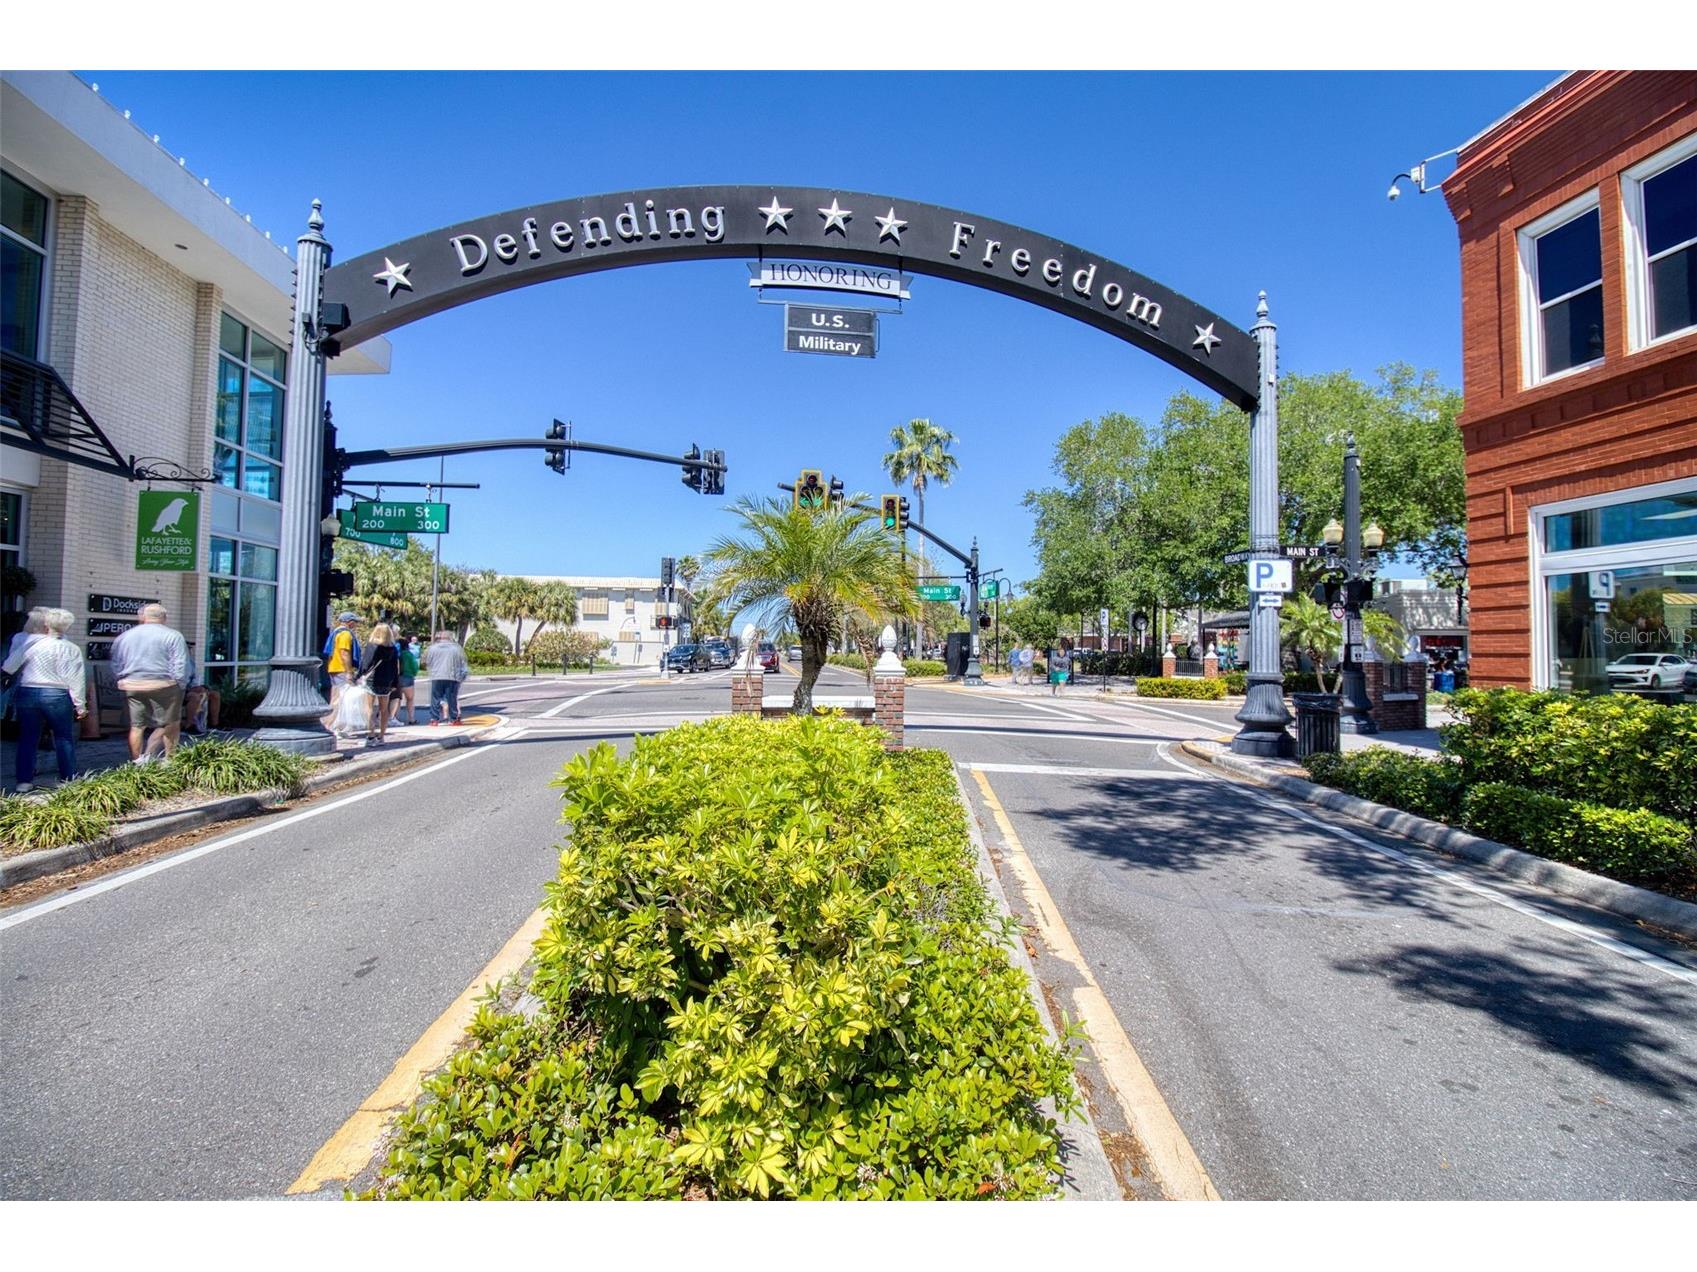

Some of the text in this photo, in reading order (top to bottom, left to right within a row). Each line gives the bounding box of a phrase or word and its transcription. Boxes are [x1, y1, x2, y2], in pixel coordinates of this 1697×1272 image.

[450, 199, 1164, 328] Defending Freedom
[769, 263, 893, 291] HONORING
[811, 312, 851, 329] U.S.
[799, 335, 862, 356] Military
[372, 505, 430, 518] Main St
[362, 519, 440, 530] 200 300
[389, 536, 404, 546] 800
[141, 544, 193, 555] RUSHFORD
[1286, 547, 1319, 557] MAIN ST
[1256, 563, 1274, 589] P
